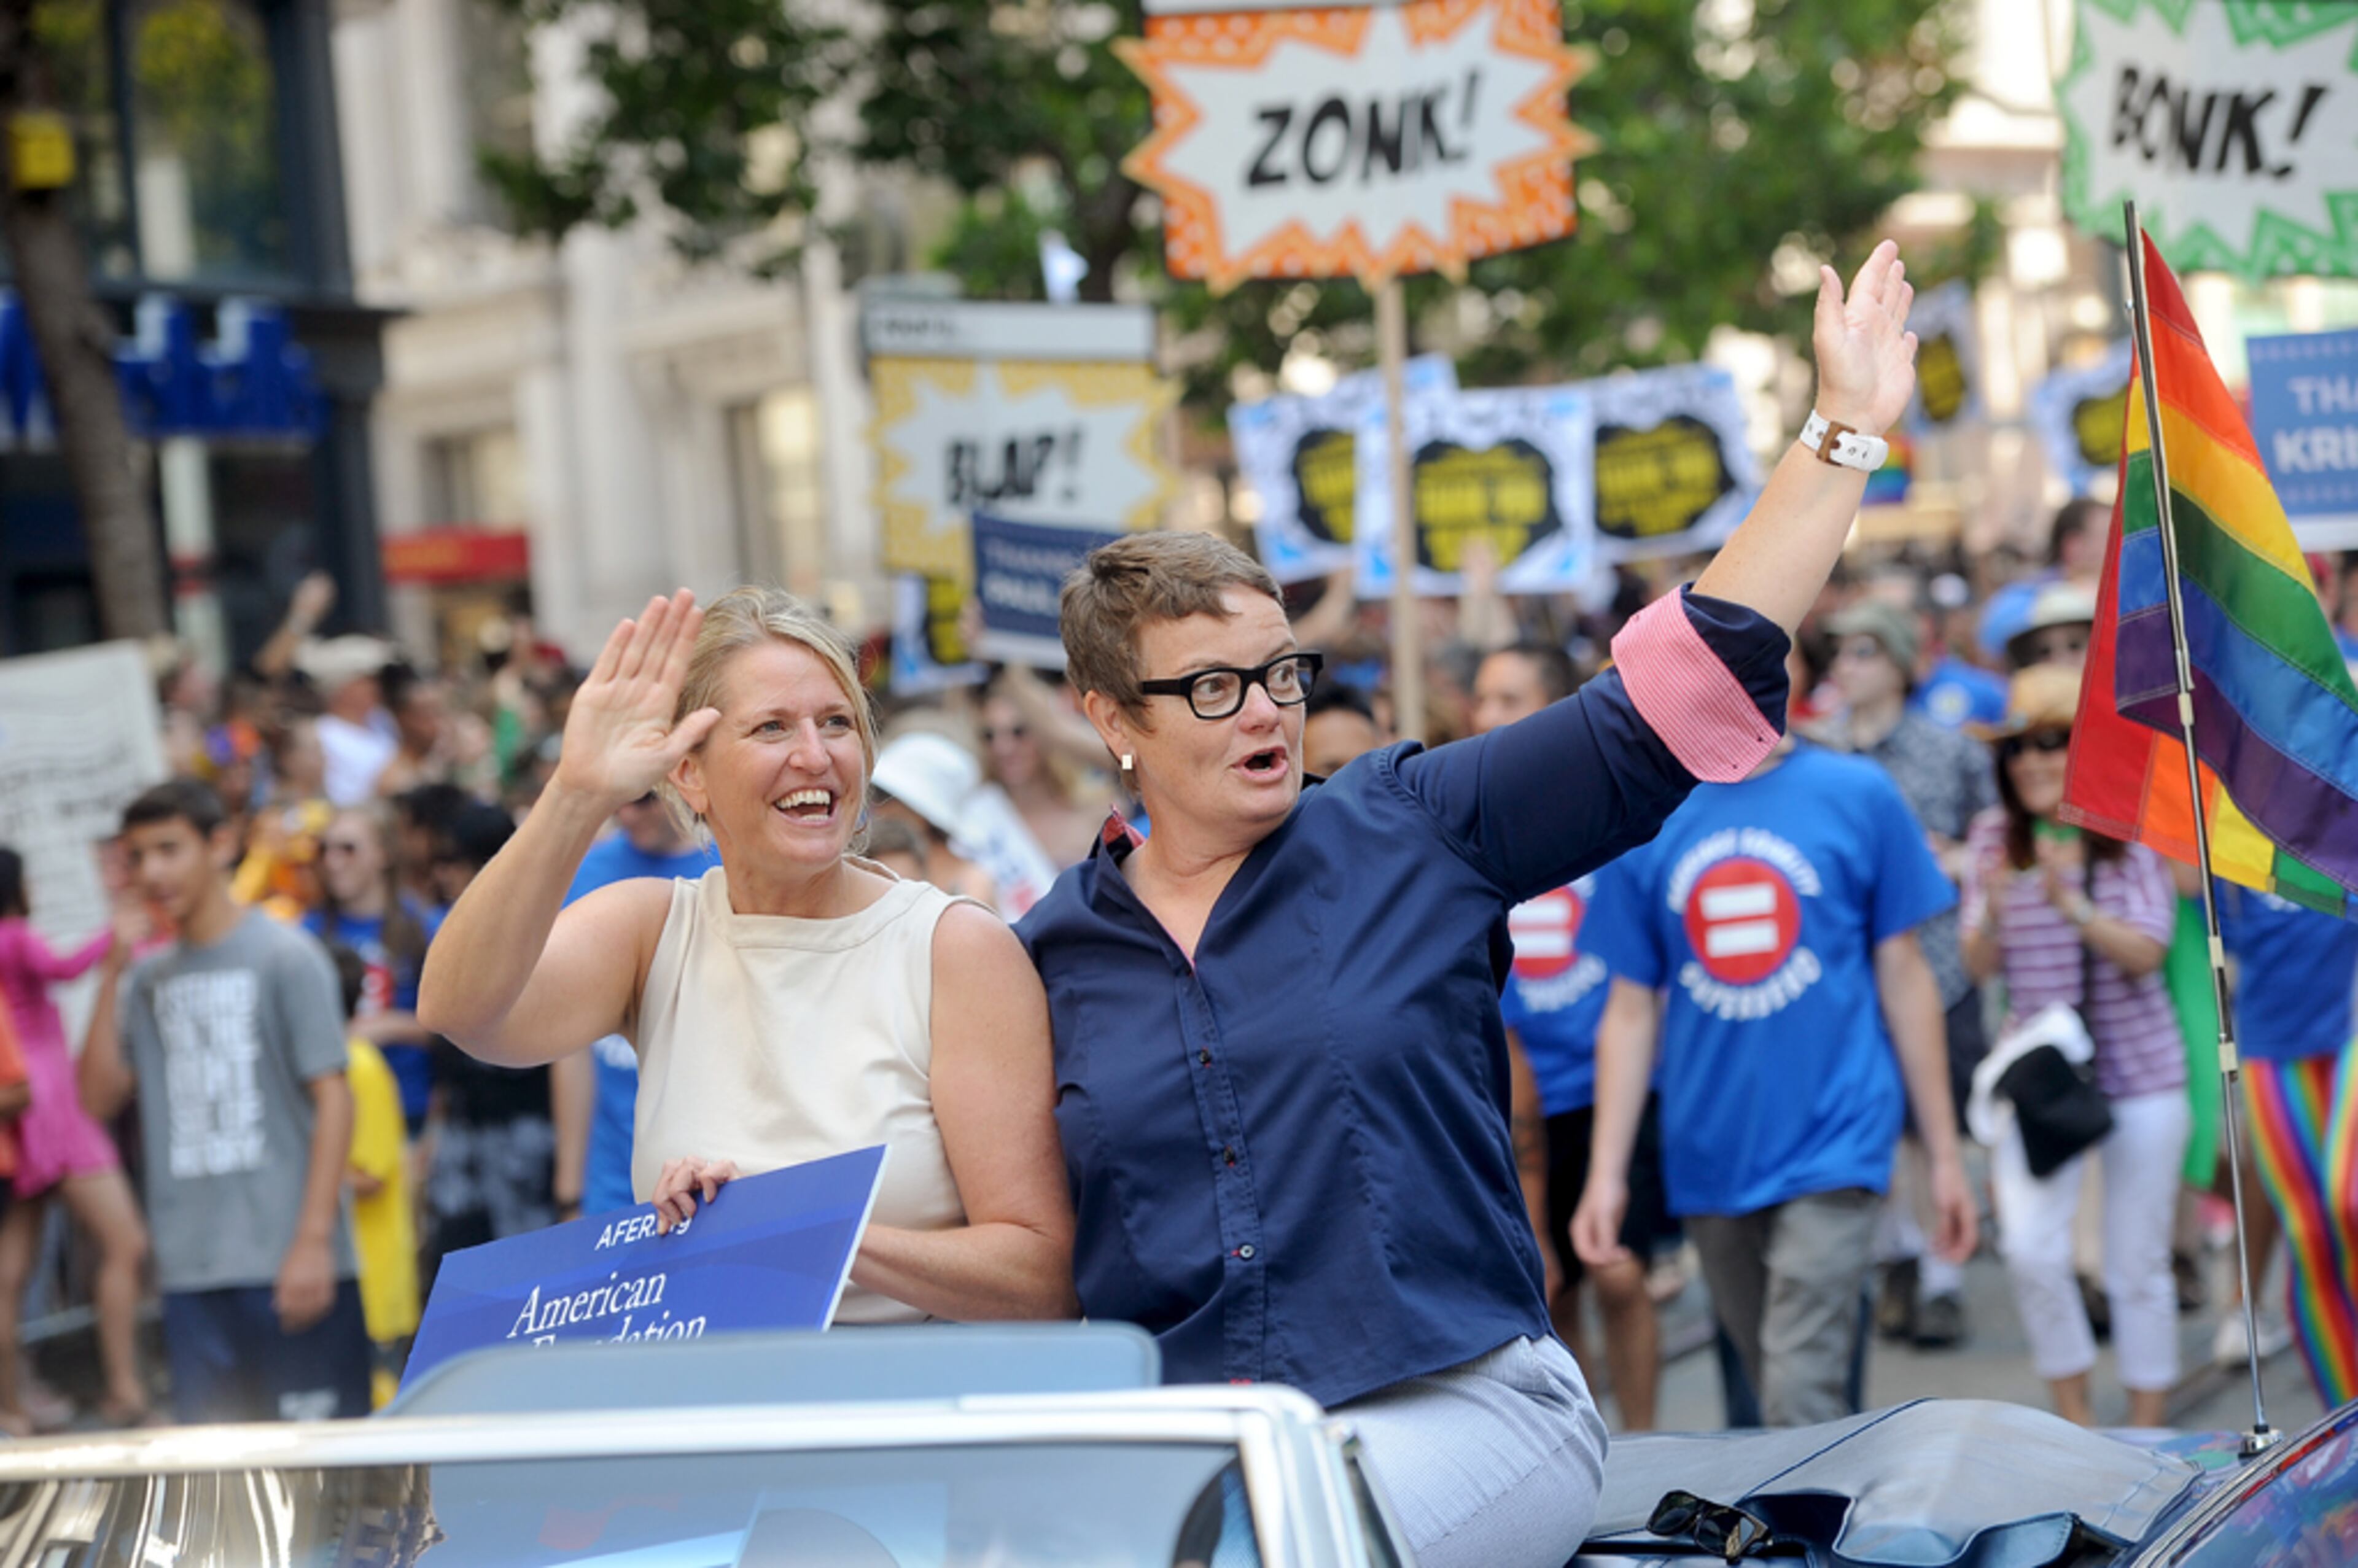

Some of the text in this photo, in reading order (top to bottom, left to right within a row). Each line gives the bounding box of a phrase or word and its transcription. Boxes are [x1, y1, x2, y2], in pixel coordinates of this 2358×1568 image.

[1247, 68, 1481, 188] ZONK!
[2113, 66, 2327, 179] BONK!
[594, 1214, 691, 1251] AFER.g
[506, 1271, 666, 1339] American
[532, 1310, 706, 1345] dation
